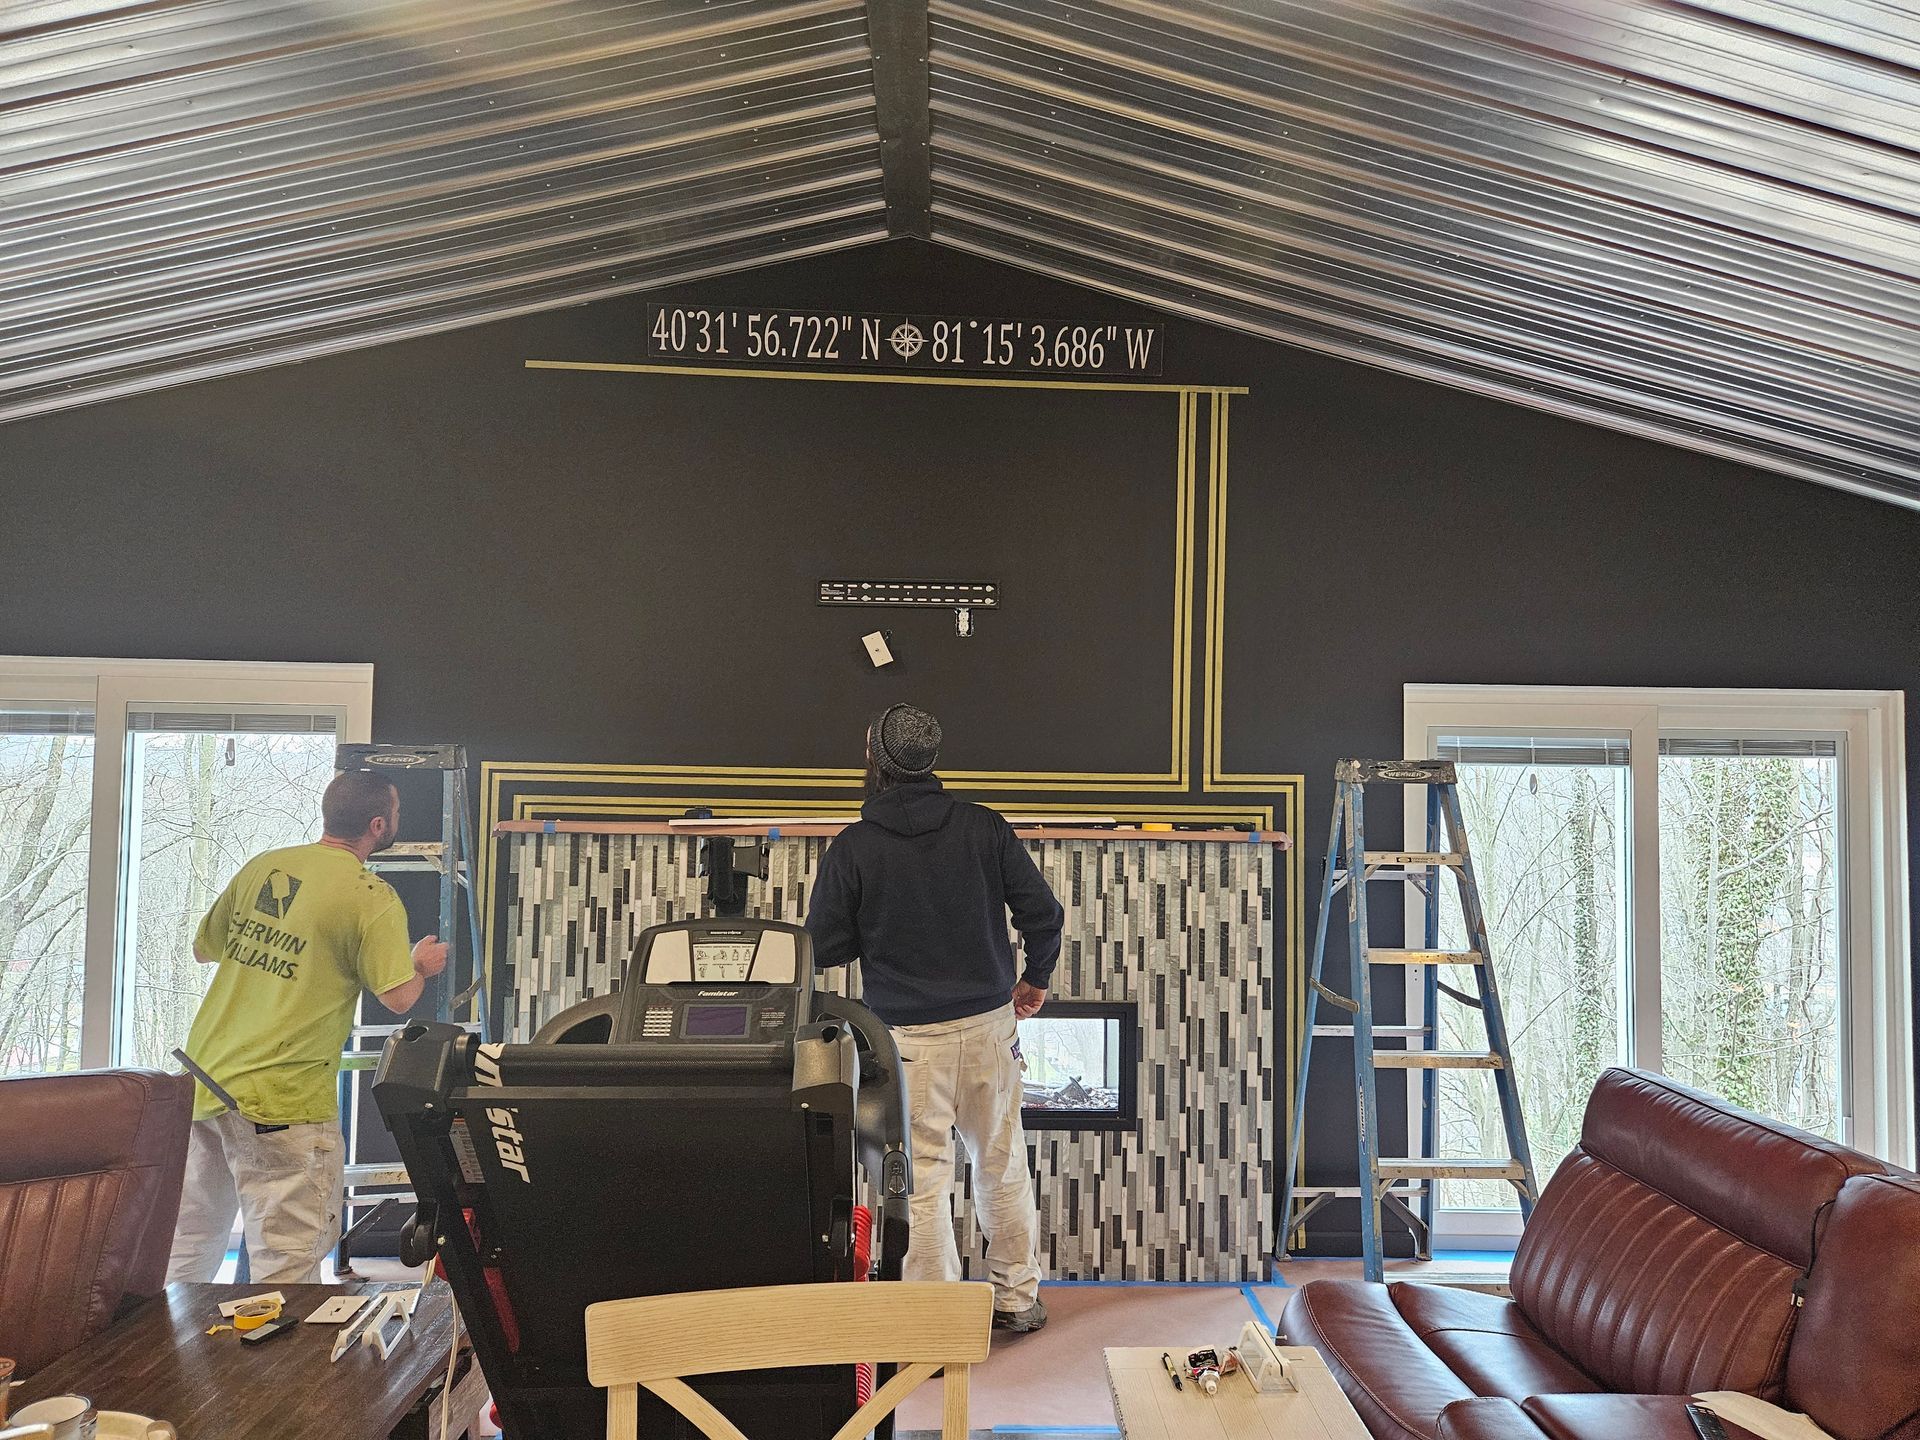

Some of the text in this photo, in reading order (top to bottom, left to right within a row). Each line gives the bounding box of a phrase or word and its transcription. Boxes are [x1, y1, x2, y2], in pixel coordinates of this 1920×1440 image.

[748, 313, 851, 358] 56.722"
[861, 318, 880, 360] N
[1030, 325, 1117, 368] 3.686"
[1124, 328, 1154, 369] W
[1387, 770, 1422, 778] WERNER
